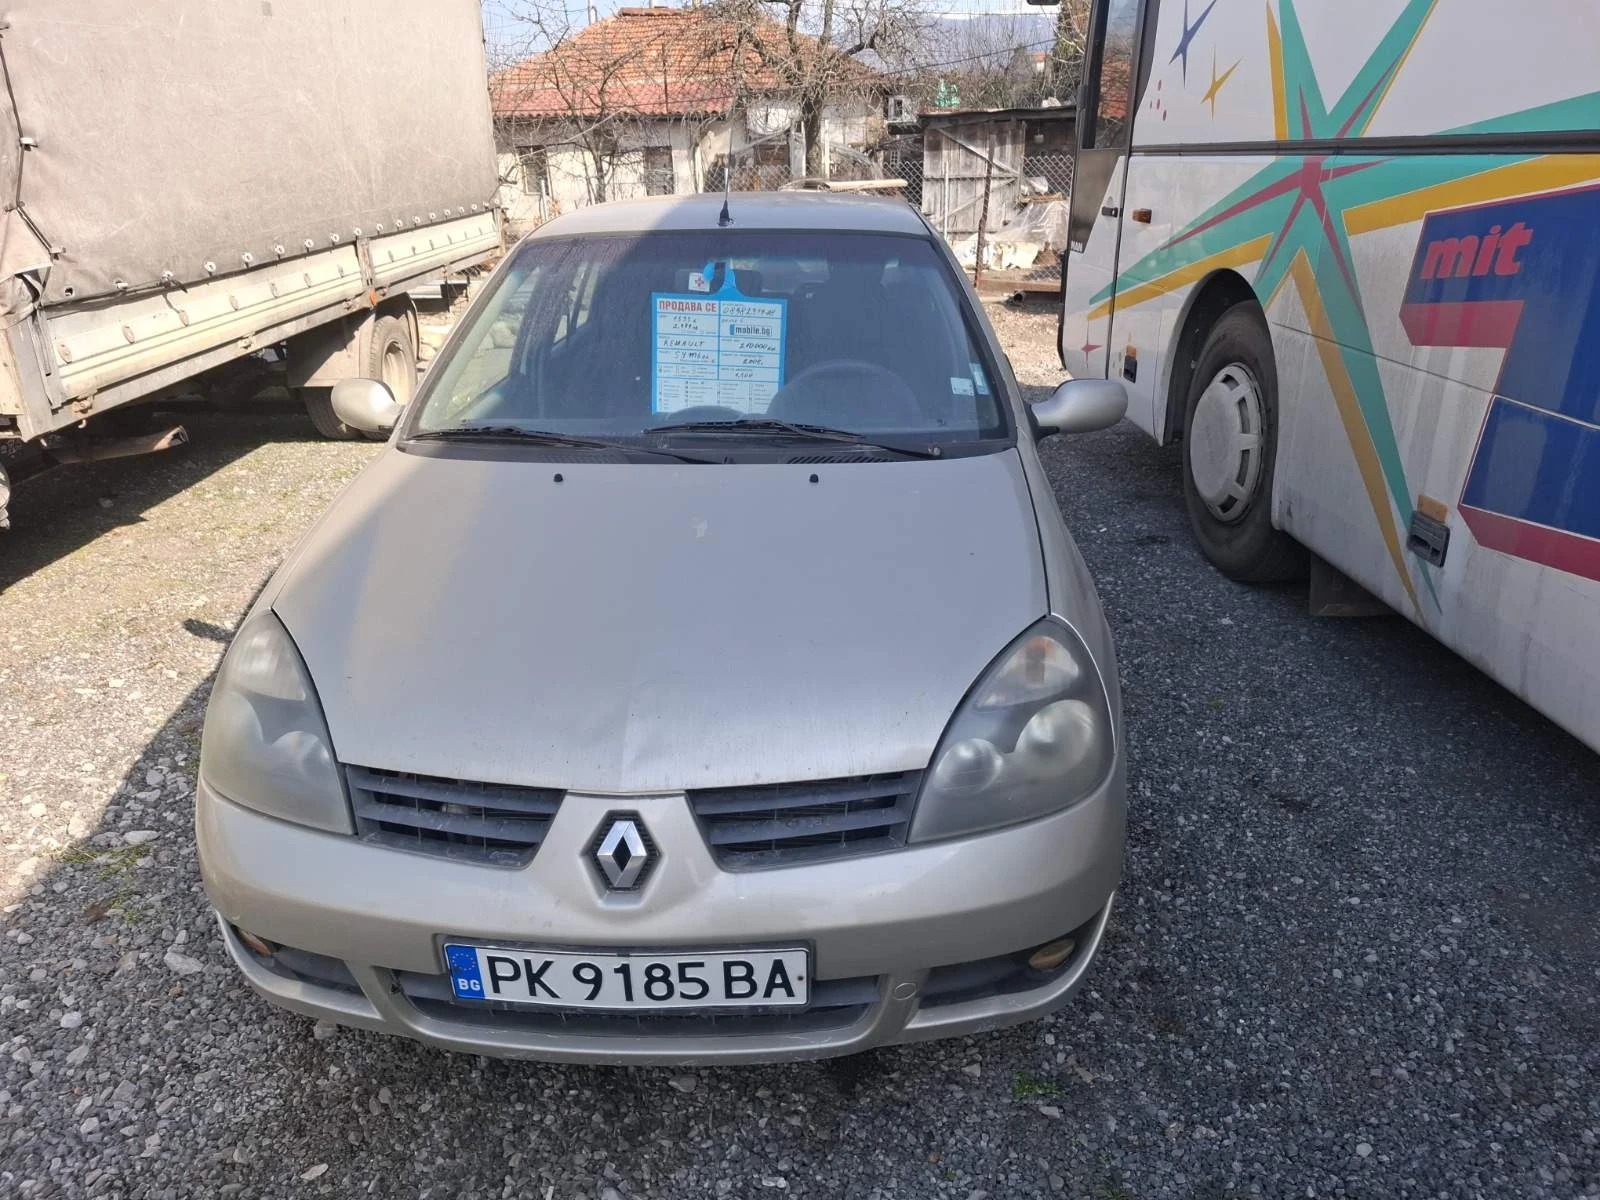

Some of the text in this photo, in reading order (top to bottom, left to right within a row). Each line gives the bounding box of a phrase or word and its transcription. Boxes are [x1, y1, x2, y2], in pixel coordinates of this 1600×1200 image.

[1420, 222, 1534, 280] mit
[659, 300, 717, 312] ПРОДАВА СЕ
[735, 325, 771, 336] mobile.bg
[458, 978, 481, 992] BG
[486, 955, 796, 1002] PK 9185 BA
